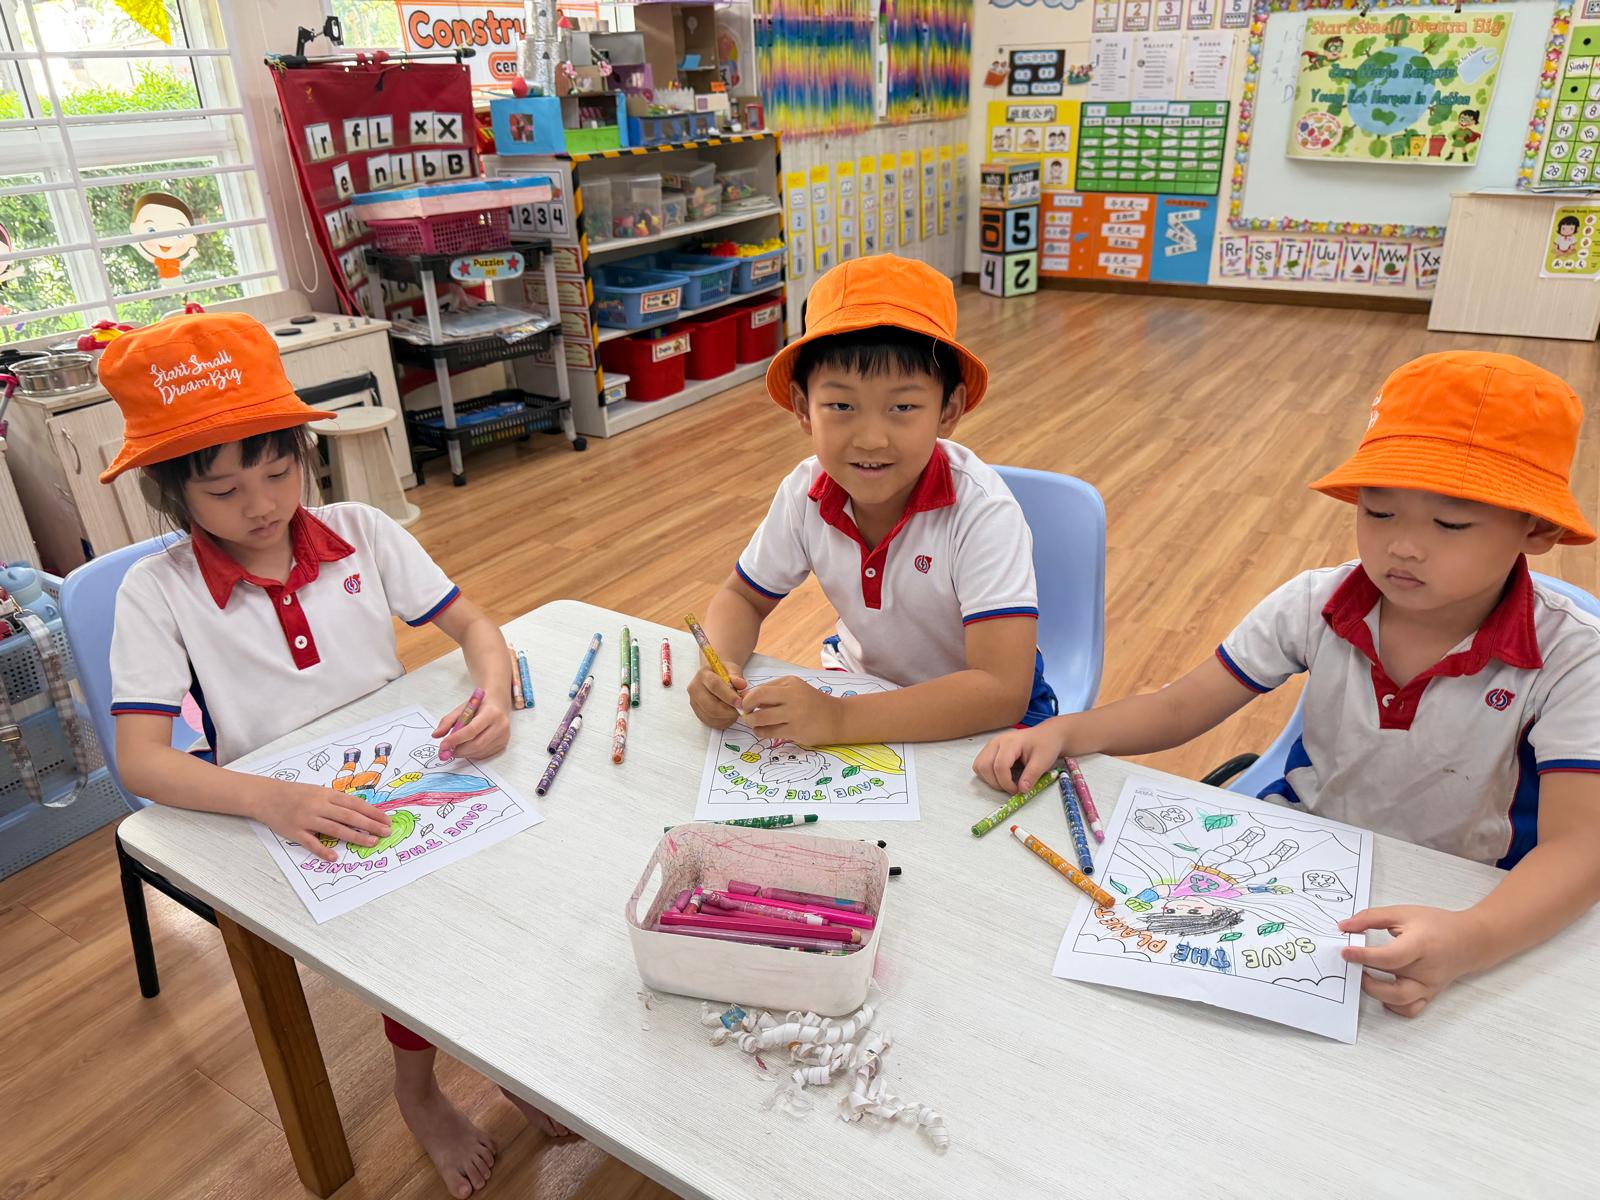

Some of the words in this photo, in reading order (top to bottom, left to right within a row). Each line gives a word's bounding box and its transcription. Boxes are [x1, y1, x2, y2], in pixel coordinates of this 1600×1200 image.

[1133, 3, 1143, 17] 2
[1164, 2, 1174, 15] 3
[1311, 20, 1352, 35] Start
[1354, 19, 1403, 35] Small
[1406, 19, 1468, 34] Dream
[1472, 17, 1505, 37] Big
[1568, 61, 1590, 73] Sunday
[1565, 105, 1572, 116] 7
[1589, 105, 1598, 117] 8
[352, 122, 361, 147] f
[1559, 126, 1570, 136] 14
[1583, 127, 1595, 140] 15
[1554, 144, 1566, 156] 21
[1578, 147, 1593, 159] 22
[1546, 164, 1560, 177] 28
[1573, 167, 1587, 178] 29
[521, 207, 533, 225] 2
[537, 207, 548, 226] 3
[553, 207, 564, 227] 4
[1012, 212, 1031, 246] 5
[473, 257, 505, 268] Puzzles
[1224, 242, 1243, 257] Rr
[1254, 245, 1273, 261] Ss
[1286, 244, 1304, 260] Tt
[1315, 245, 1336, 260] Uu
[1350, 246, 1370, 261] Vv
[1379, 247, 1407, 262] Ww
[1420, 251, 1441, 267] Xx
[984, 260, 996, 290] 4
[149, 363, 191, 388] Start
[188, 349, 232, 376] Small
[158, 378, 210, 406] Dream
[208, 368, 243, 391] Big
[717, 764, 780, 798] PLANET
[833, 777, 885, 798] SAVE
[784, 788, 827, 801] THE
[443, 802, 488, 838] SAVE
[396, 838, 443, 862] THE
[300, 857, 389, 875] PLANET
[1093, 906, 1169, 954] PLANET
[1173, 943, 1232, 970] THE
[1241, 936, 1317, 969] SAVE
